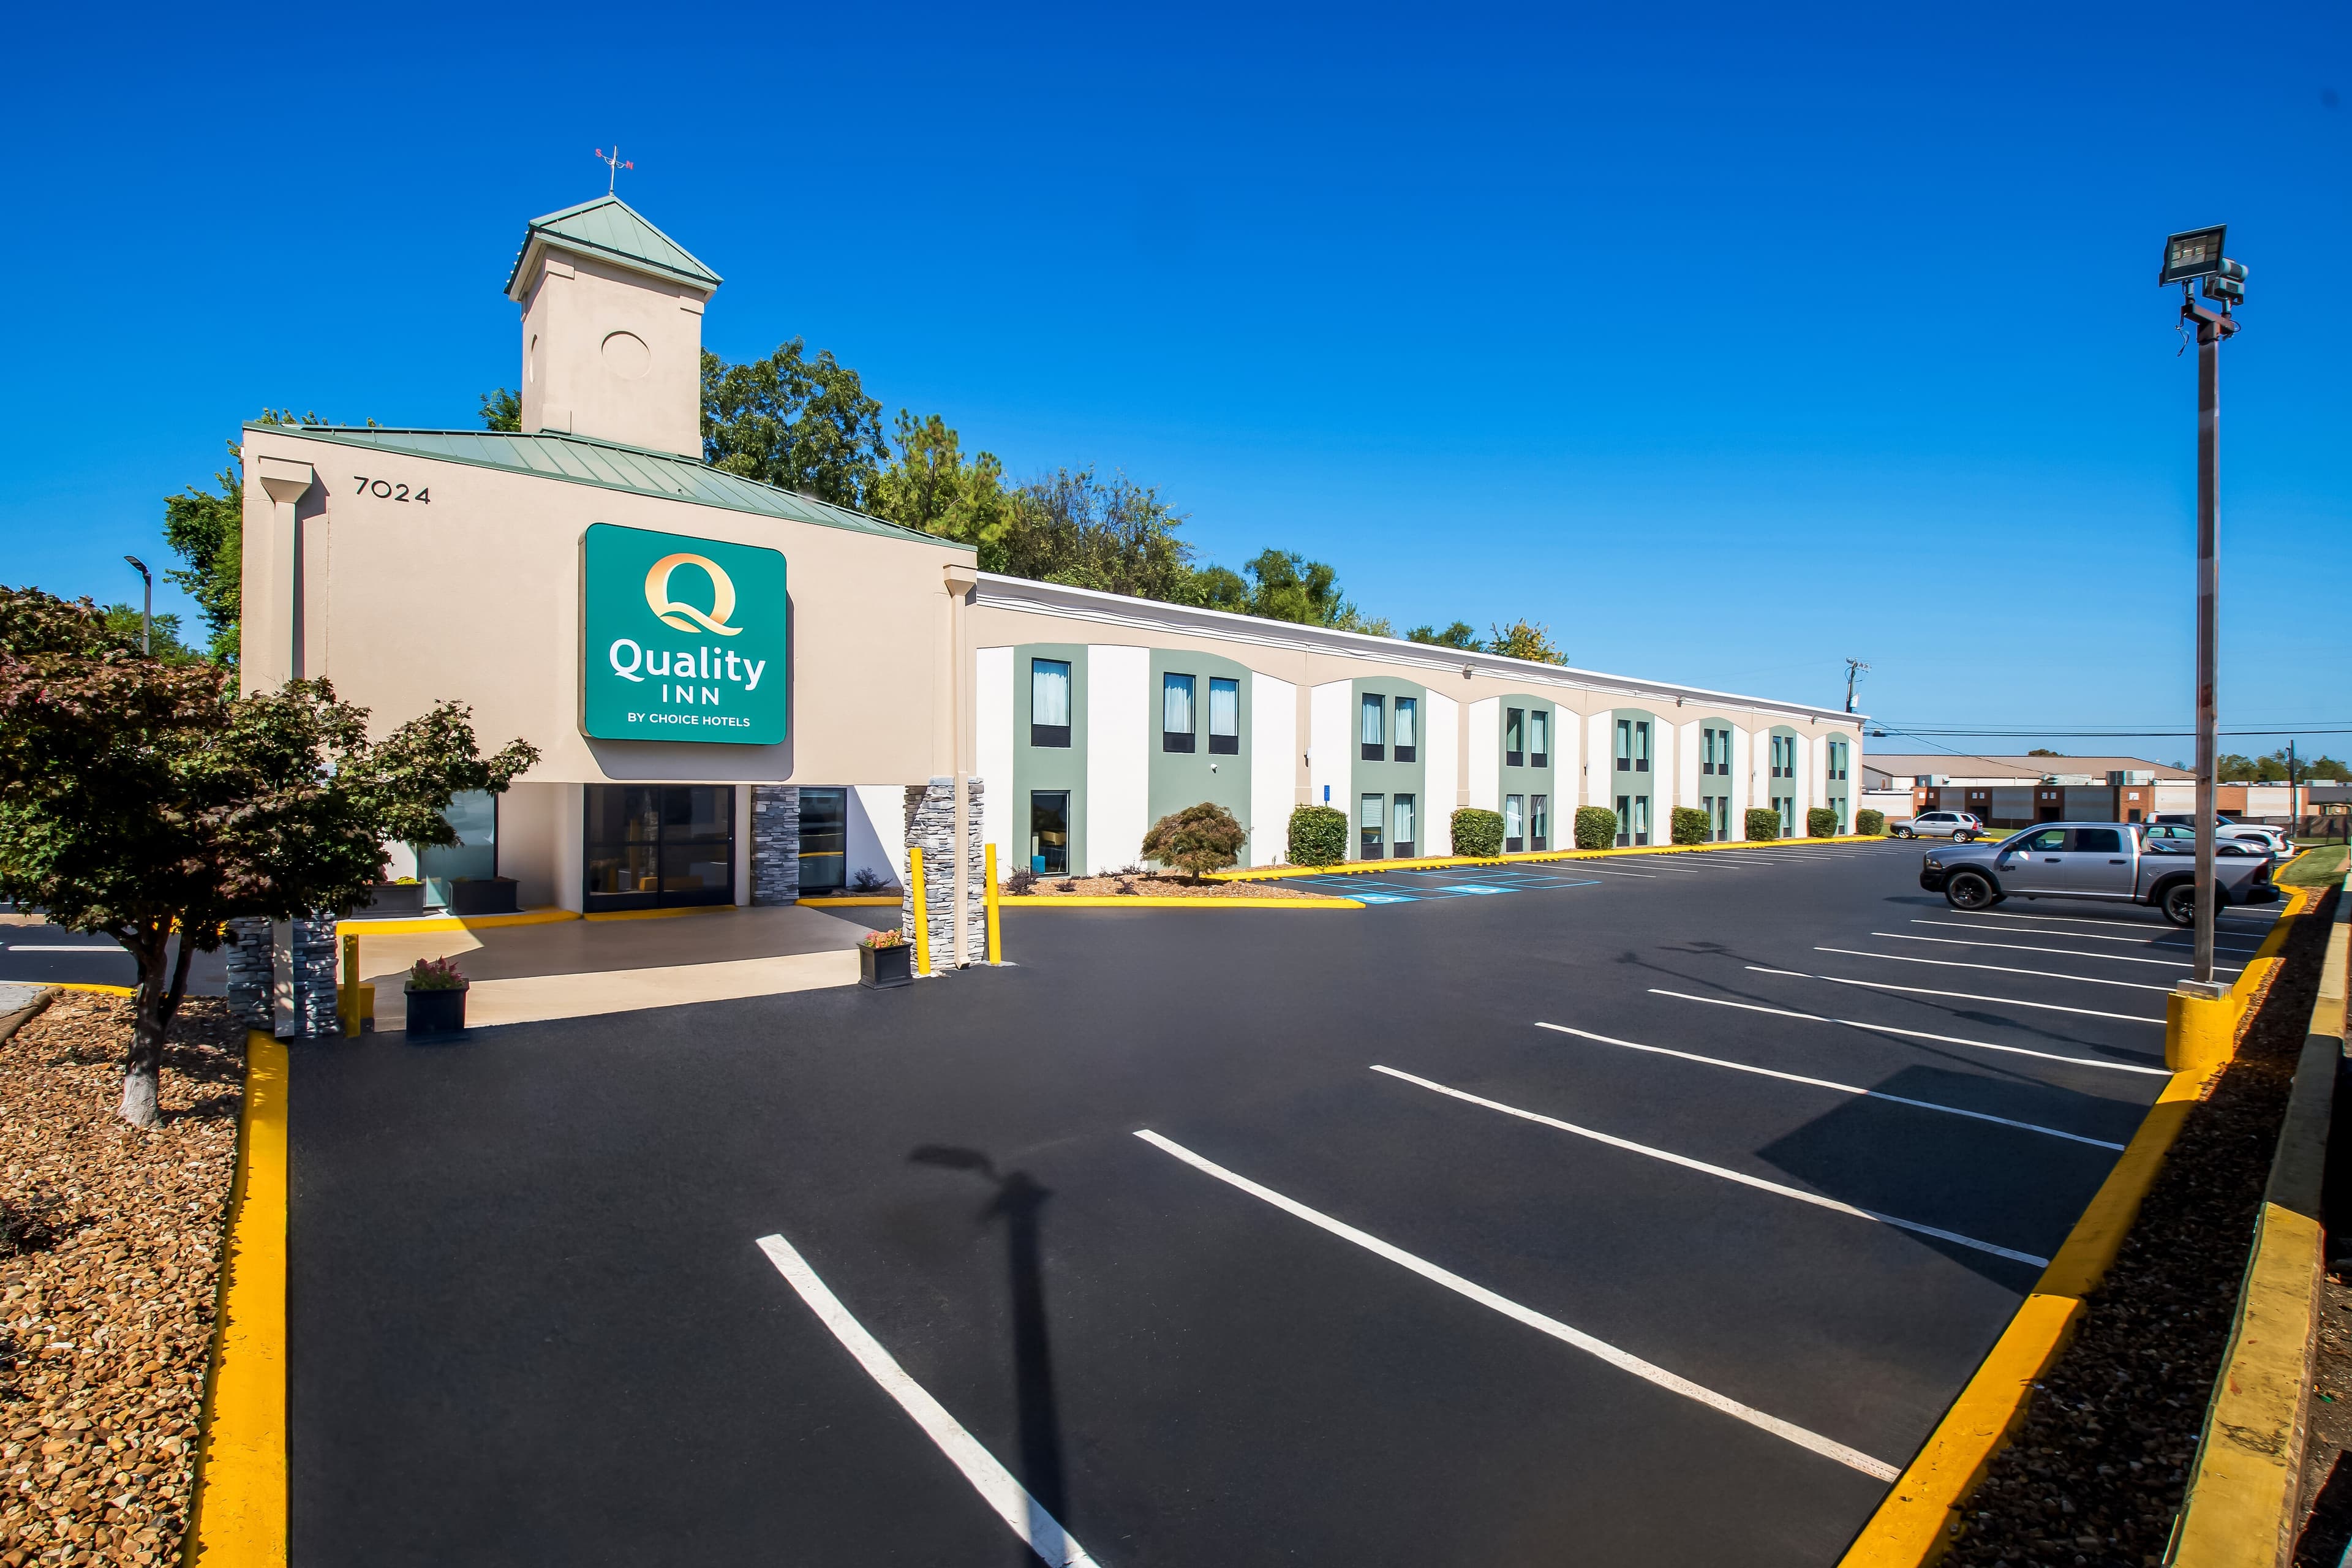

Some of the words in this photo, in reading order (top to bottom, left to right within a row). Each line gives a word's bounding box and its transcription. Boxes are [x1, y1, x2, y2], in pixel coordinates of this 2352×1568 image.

[353, 476, 431, 504] 7024
[645, 553, 744, 636] Q
[609, 638, 766, 691] Quality
[662, 684, 720, 705] INN
[628, 712, 646, 722] BY
[649, 714, 699, 725] CHOICE
[703, 716, 750, 727] HOTELS
